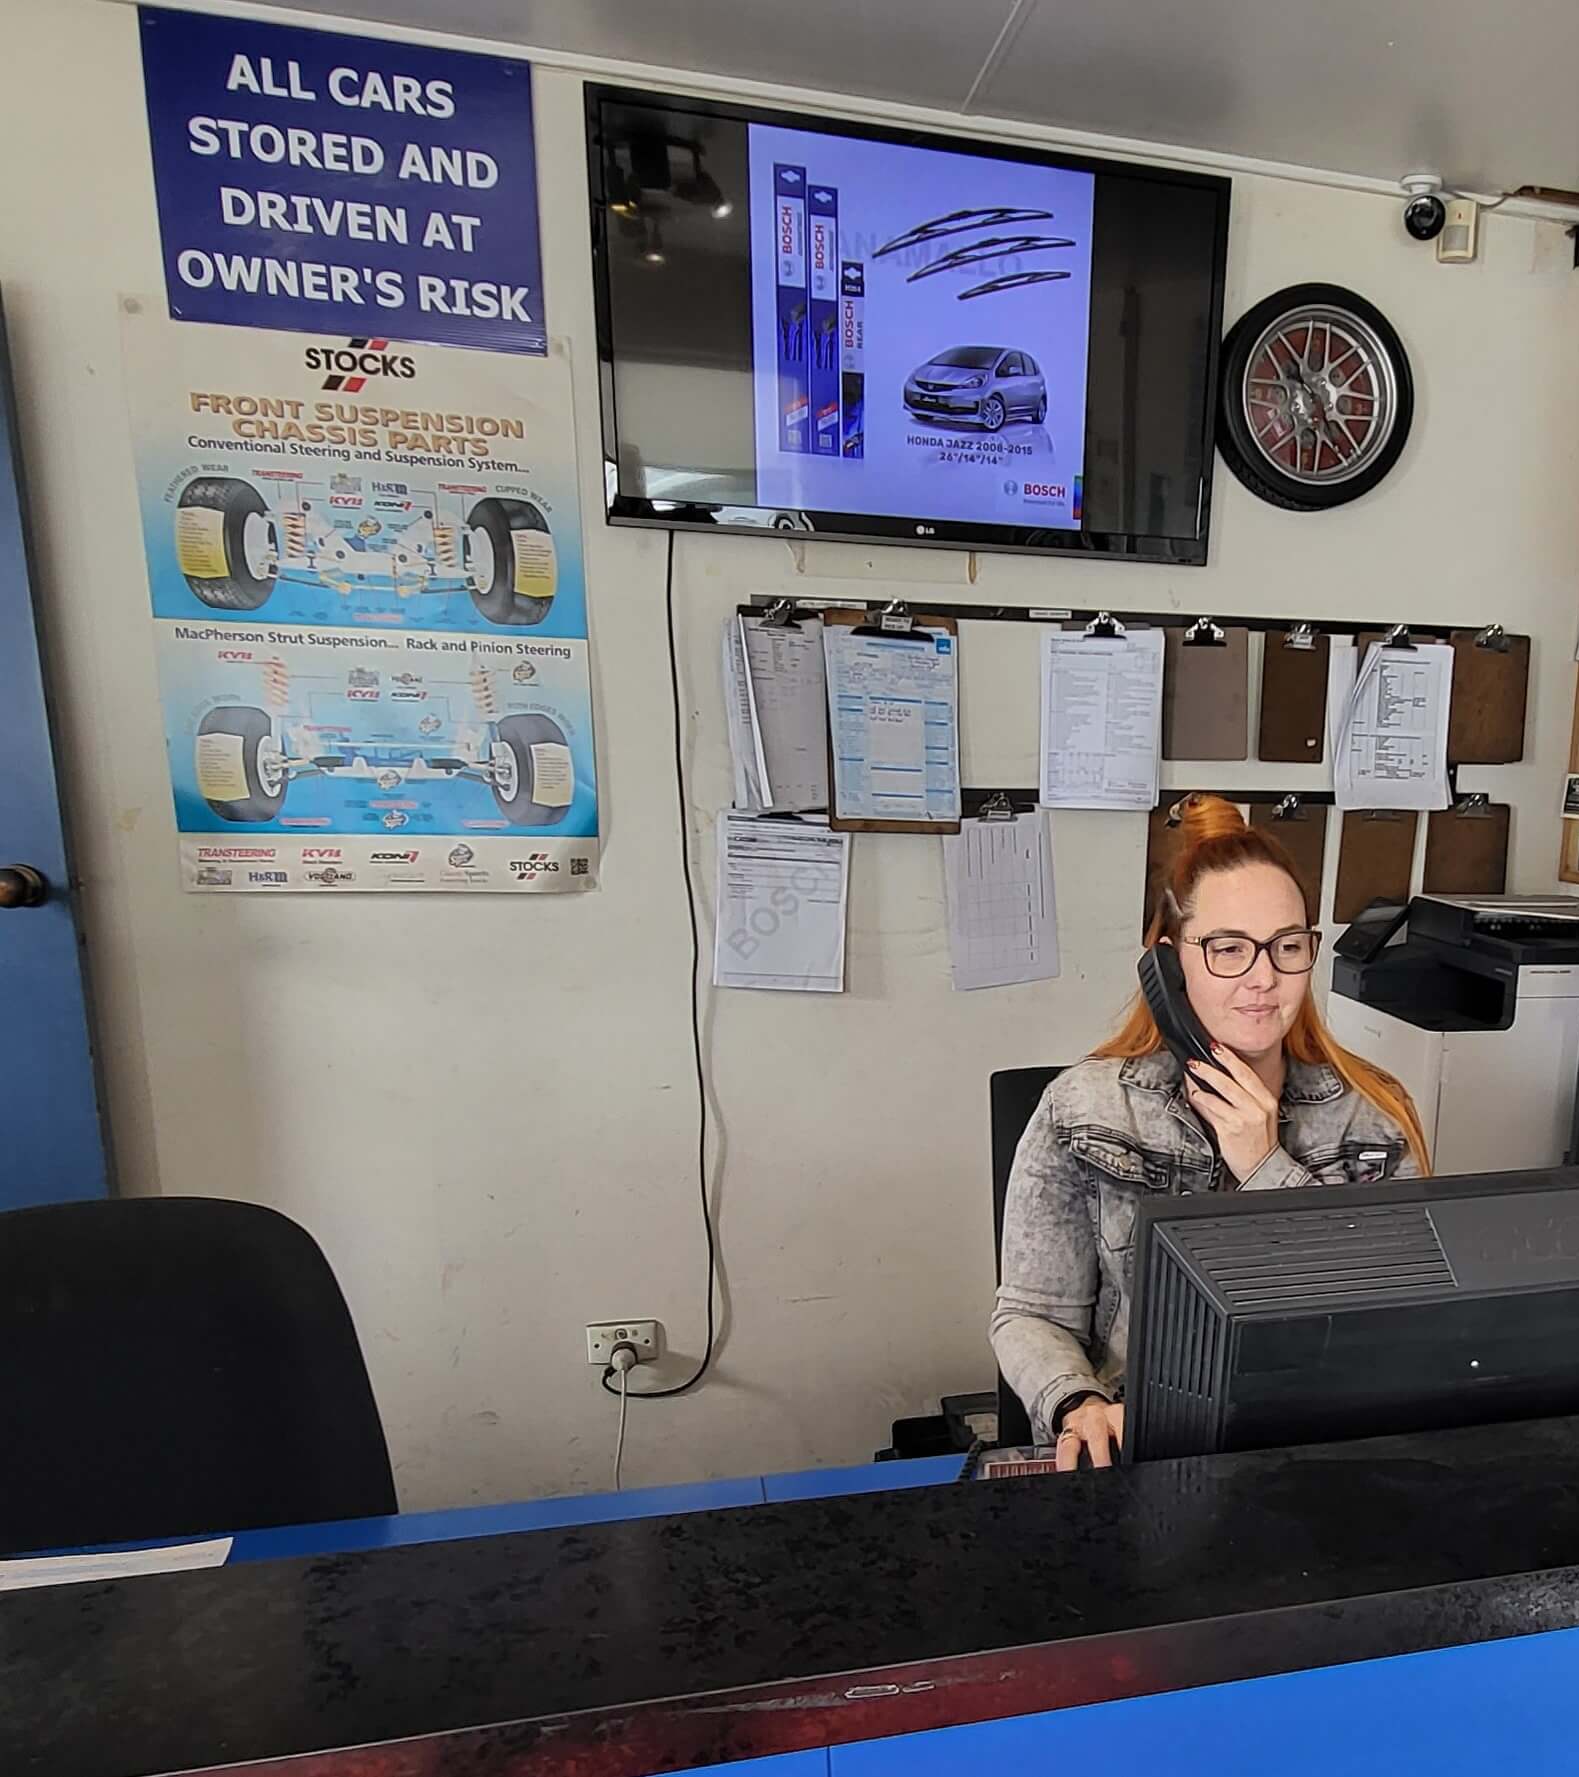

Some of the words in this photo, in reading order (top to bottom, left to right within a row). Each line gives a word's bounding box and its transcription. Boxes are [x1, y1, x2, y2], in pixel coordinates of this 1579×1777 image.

[226, 53, 316, 100] ALL
[328, 67, 456, 119] CARS
[187, 116, 385, 175] STORED
[398, 143, 499, 189] AND
[220, 186, 408, 245] DRIVEN
[422, 212, 481, 252] AT
[782, 206, 793, 254] BOSCH
[815, 224, 825, 269] BOSCH
[177, 250, 405, 308] OWNER'S
[418, 275, 532, 322] RISK
[845, 301, 854, 348] BOSCH
[305, 347, 416, 378] STOCKS
[190, 392, 304, 419] FRONT
[314, 402, 524, 439] SUSPENSION
[188, 435, 285, 454] Conventional
[290, 443, 350, 461] Steering
[354, 449, 381, 461] and
[385, 450, 465, 467] Suspension
[232, 418, 378, 447] CHASSIS
[387, 430, 489, 457] PARTS
[907, 435, 944, 448] HONDA
[946, 439, 974, 450] JAZZ
[1023, 483, 1066, 498] BOSCH
[175, 627, 264, 644] MacPherson
[268, 631, 304, 645] Strut
[406, 638, 437, 651] Rack
[441, 639, 467, 652] and
[471, 641, 513, 654] Pinion
[516, 642, 571, 658] Steering
[197, 847, 276, 858] TRANSTEERING
[510, 861, 559, 872] STOCKS
